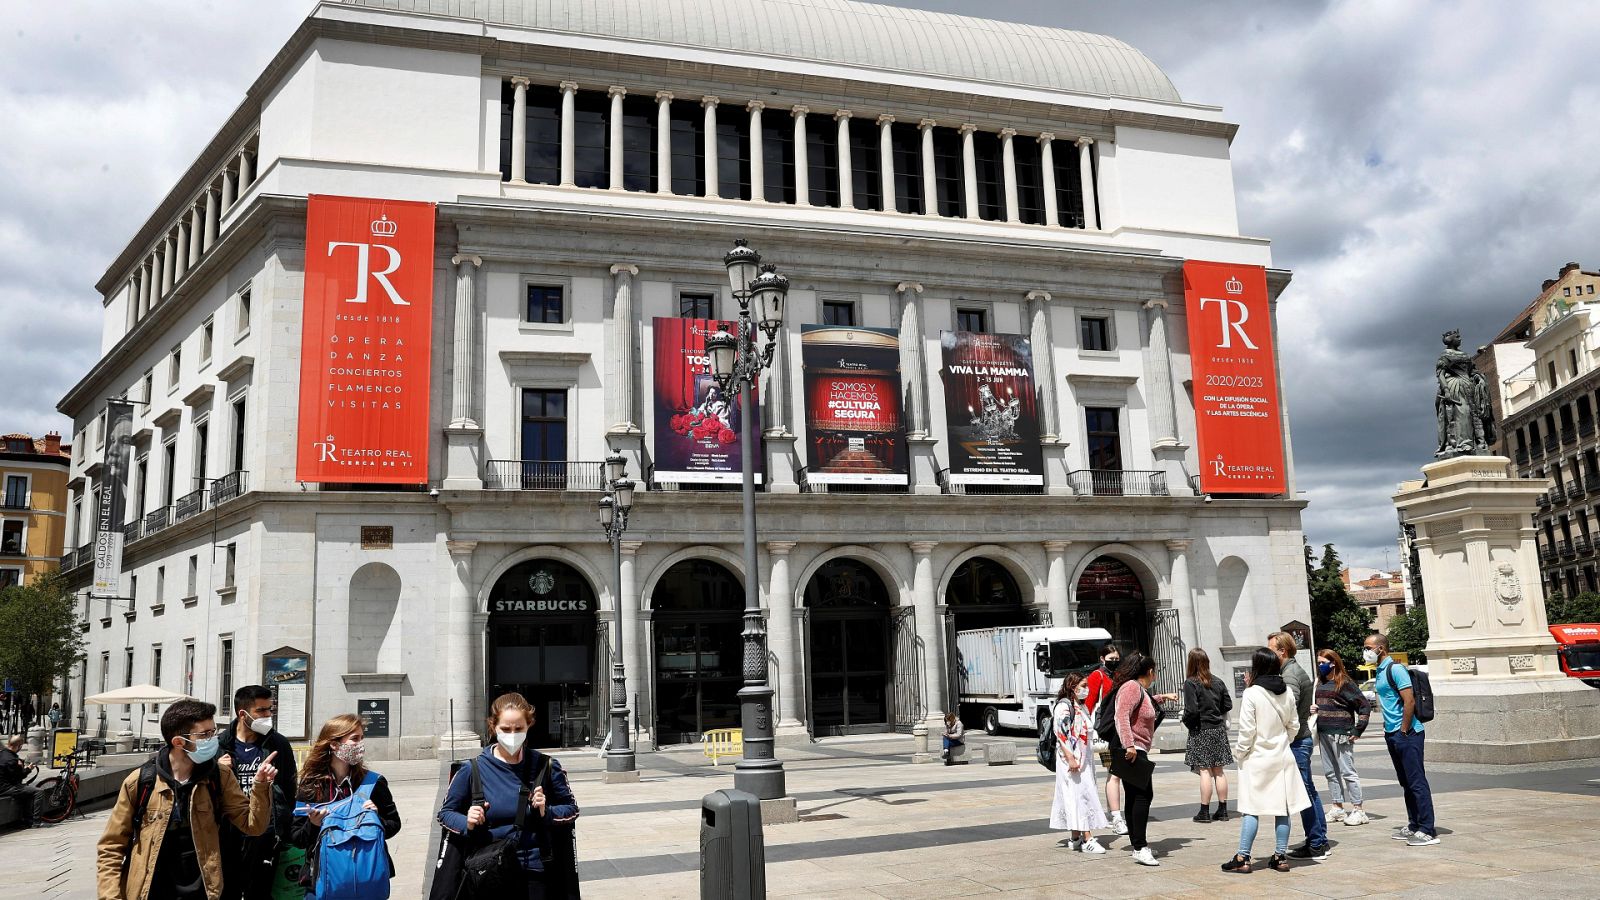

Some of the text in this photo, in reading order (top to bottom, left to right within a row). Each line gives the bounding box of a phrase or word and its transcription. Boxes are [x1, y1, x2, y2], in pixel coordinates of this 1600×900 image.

[327, 241, 411, 306] TR
[336, 314, 369, 322] desde
[1200, 297, 1259, 350] TR
[330, 335, 404, 346] ÓPERA
[330, 352, 403, 362] DANZA
[329, 367, 402, 378] CONCIERTOS
[948, 365, 1029, 377] VIVA LA MAMMA
[831, 381, 876, 391] SOMOS Y
[1205, 374, 1264, 388] 2020/2023
[328, 383, 402, 394] FLAMENCO
[830, 391, 878, 401] HACEMOS
[1224, 395, 1249, 403] DIFUSIÓN
[328, 400, 401, 410] VISITAS
[828, 400, 881, 410] #CULTURA
[834, 410, 876, 419] SEGURA
[340, 448, 413, 458] TEATRO REAL
[1472, 469, 1494, 478] ISABEL
[102, 484, 112, 505] REAL
[101, 507, 110, 516] EL
[100, 518, 109, 531] EN
[495, 600, 588, 611] STARBUCKS
